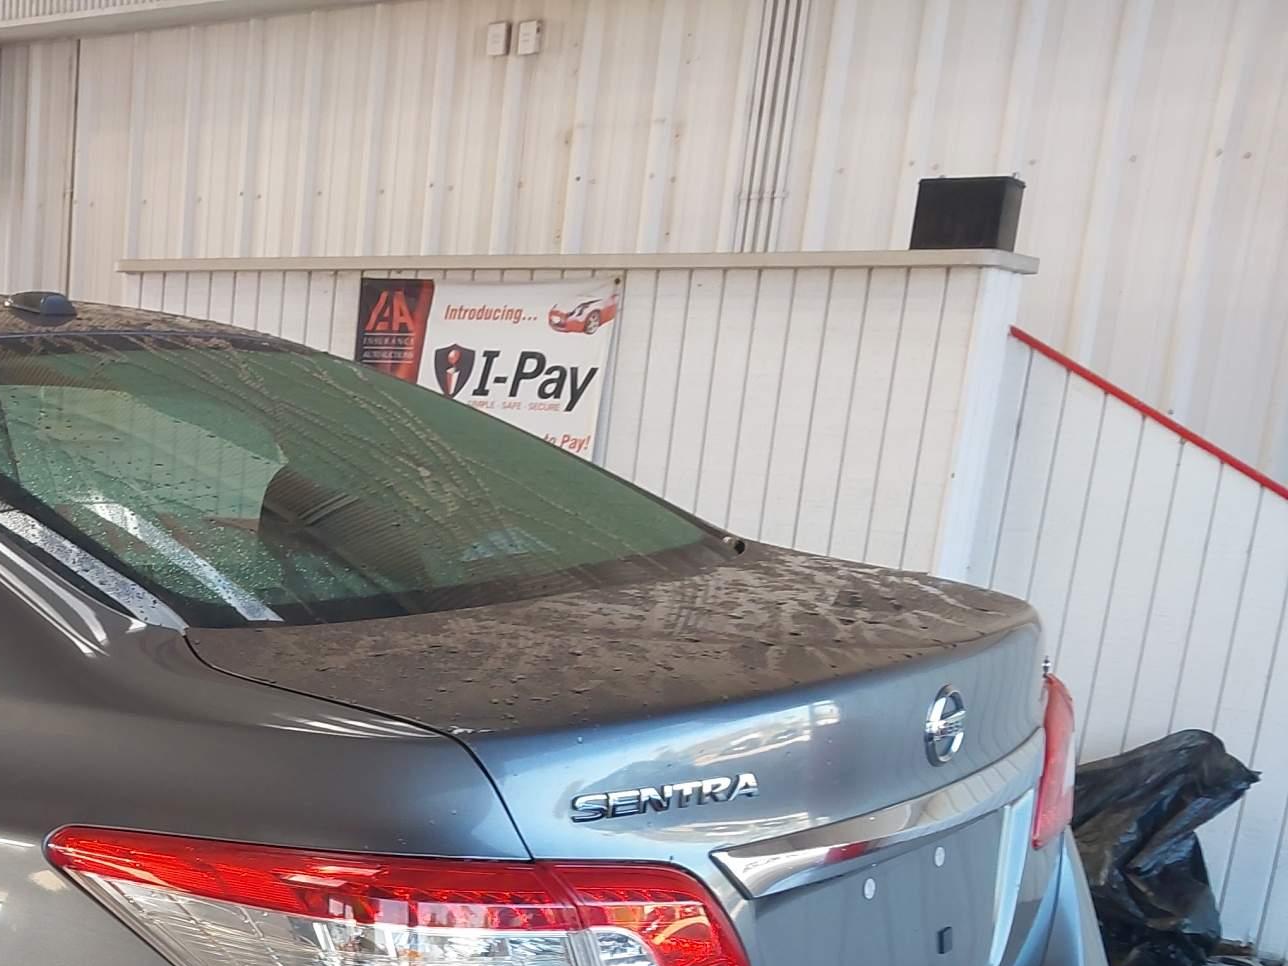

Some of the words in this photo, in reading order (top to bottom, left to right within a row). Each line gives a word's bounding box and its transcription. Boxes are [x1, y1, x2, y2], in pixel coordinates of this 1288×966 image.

[444, 304, 538, 324] Introducing...
[472, 350, 599, 412] I-Pay
[570, 773, 760, 823] SENTRA
